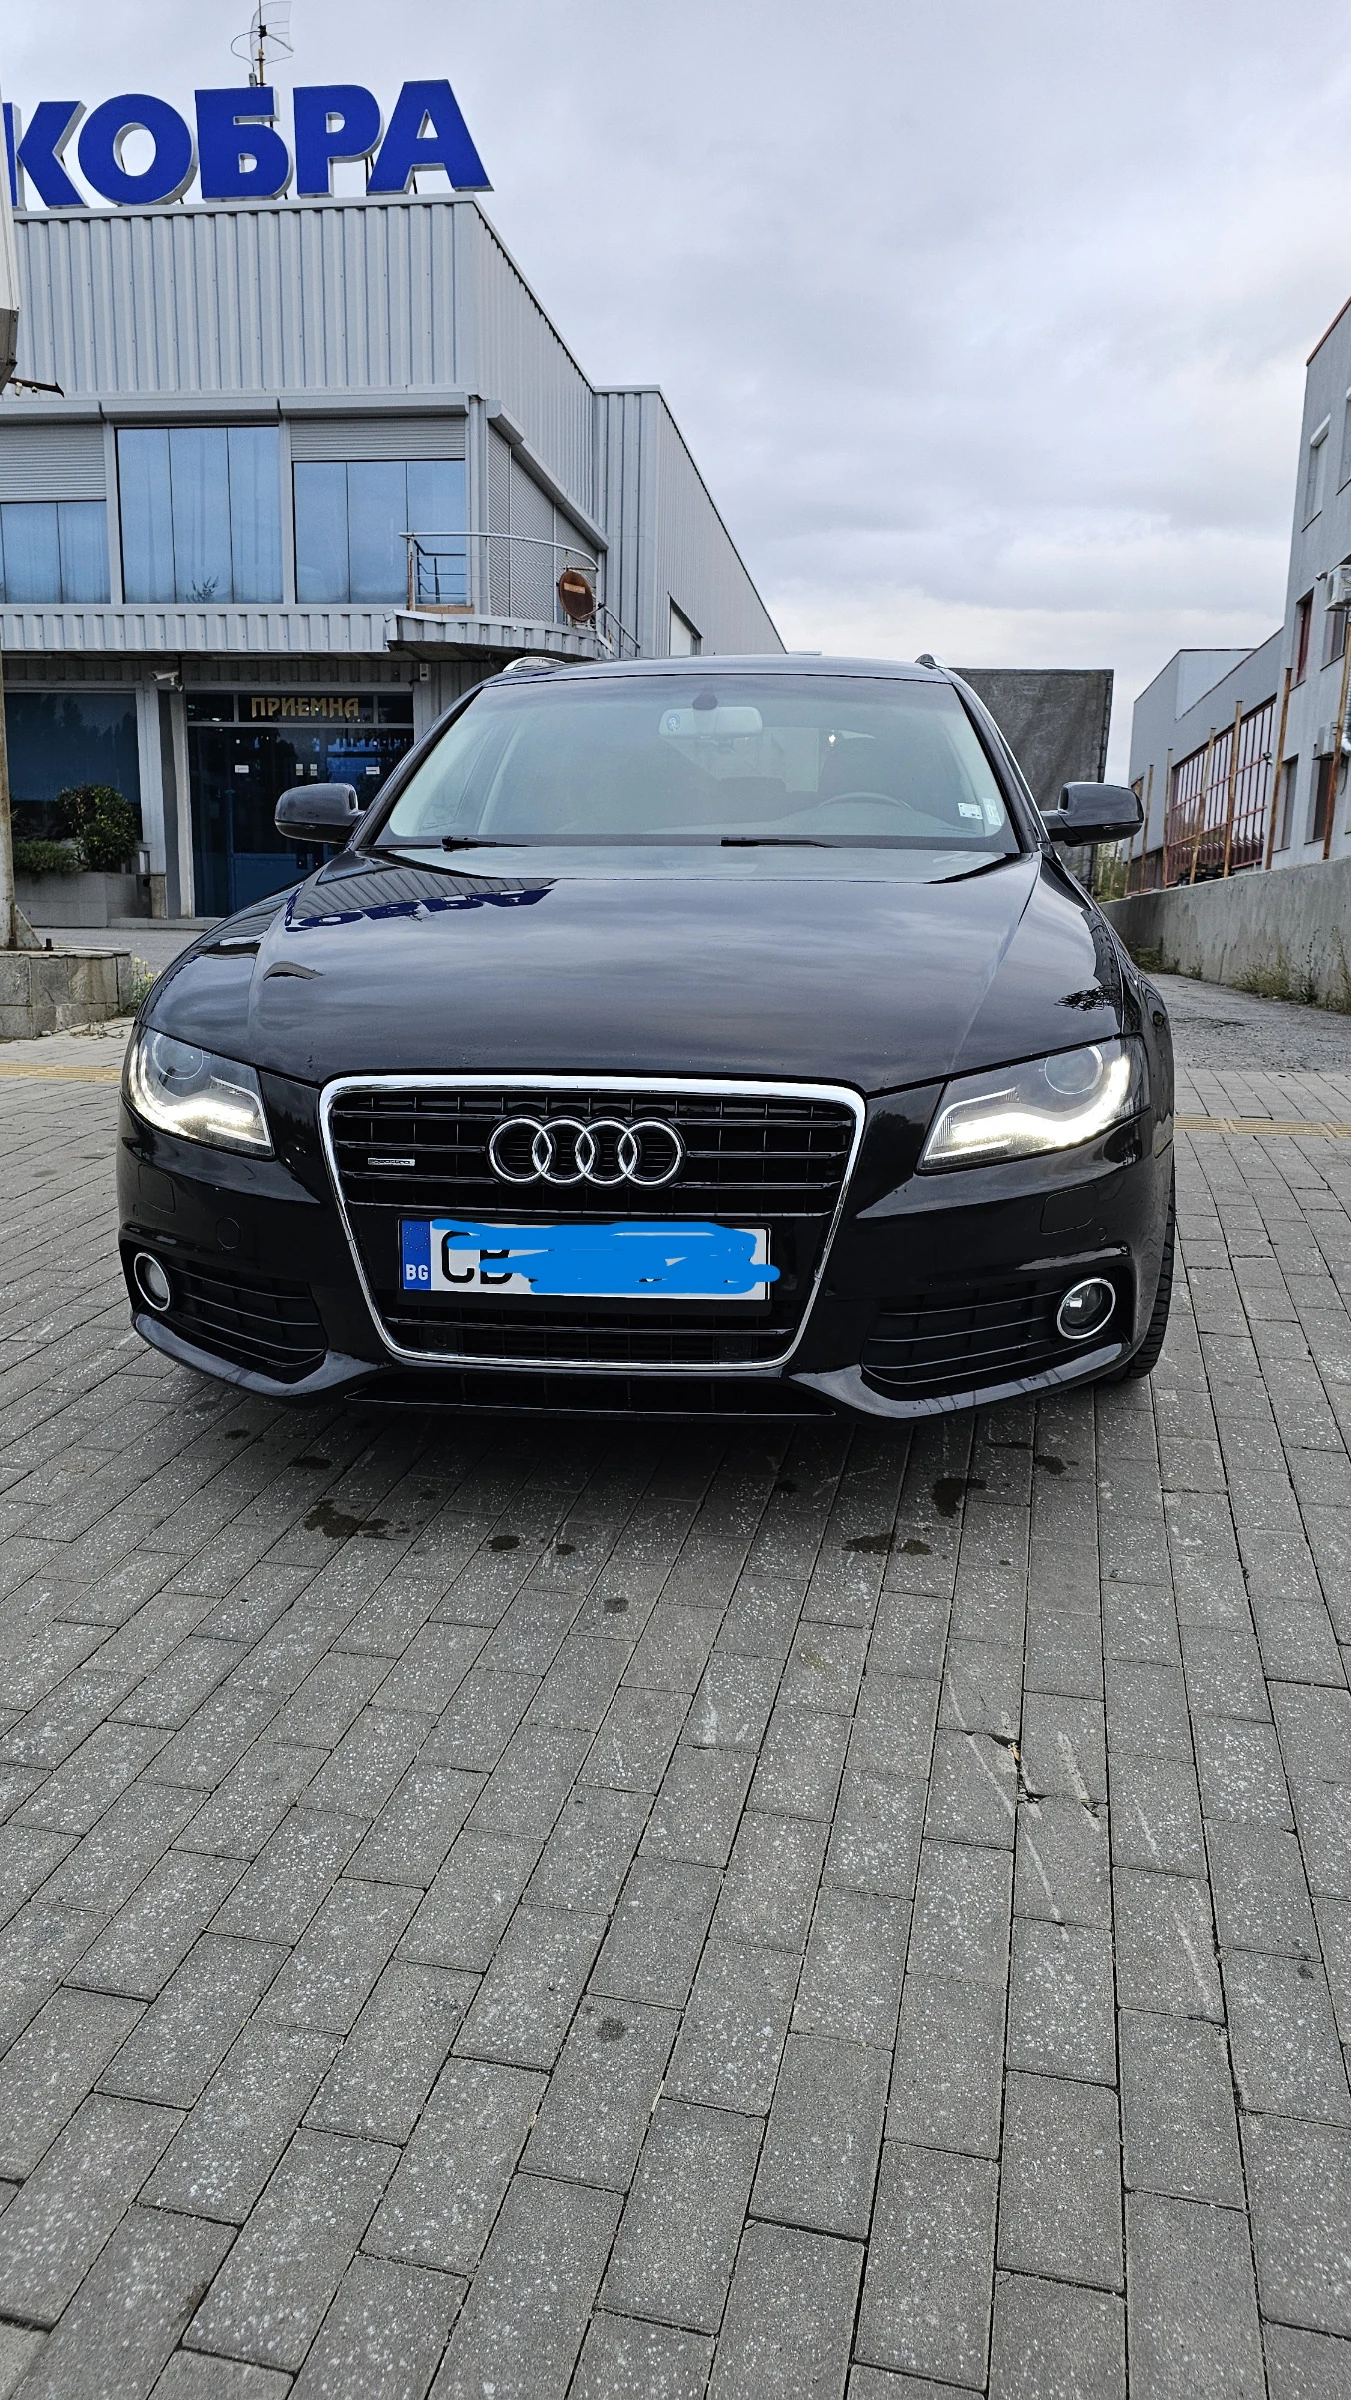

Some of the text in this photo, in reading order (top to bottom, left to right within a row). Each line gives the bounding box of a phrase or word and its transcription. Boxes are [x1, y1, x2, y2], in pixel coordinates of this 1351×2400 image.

[2, 79, 494, 208] КОБРА
[251, 697, 359, 719] ПРИЕМНА
[405, 1263, 429, 1281] BG
